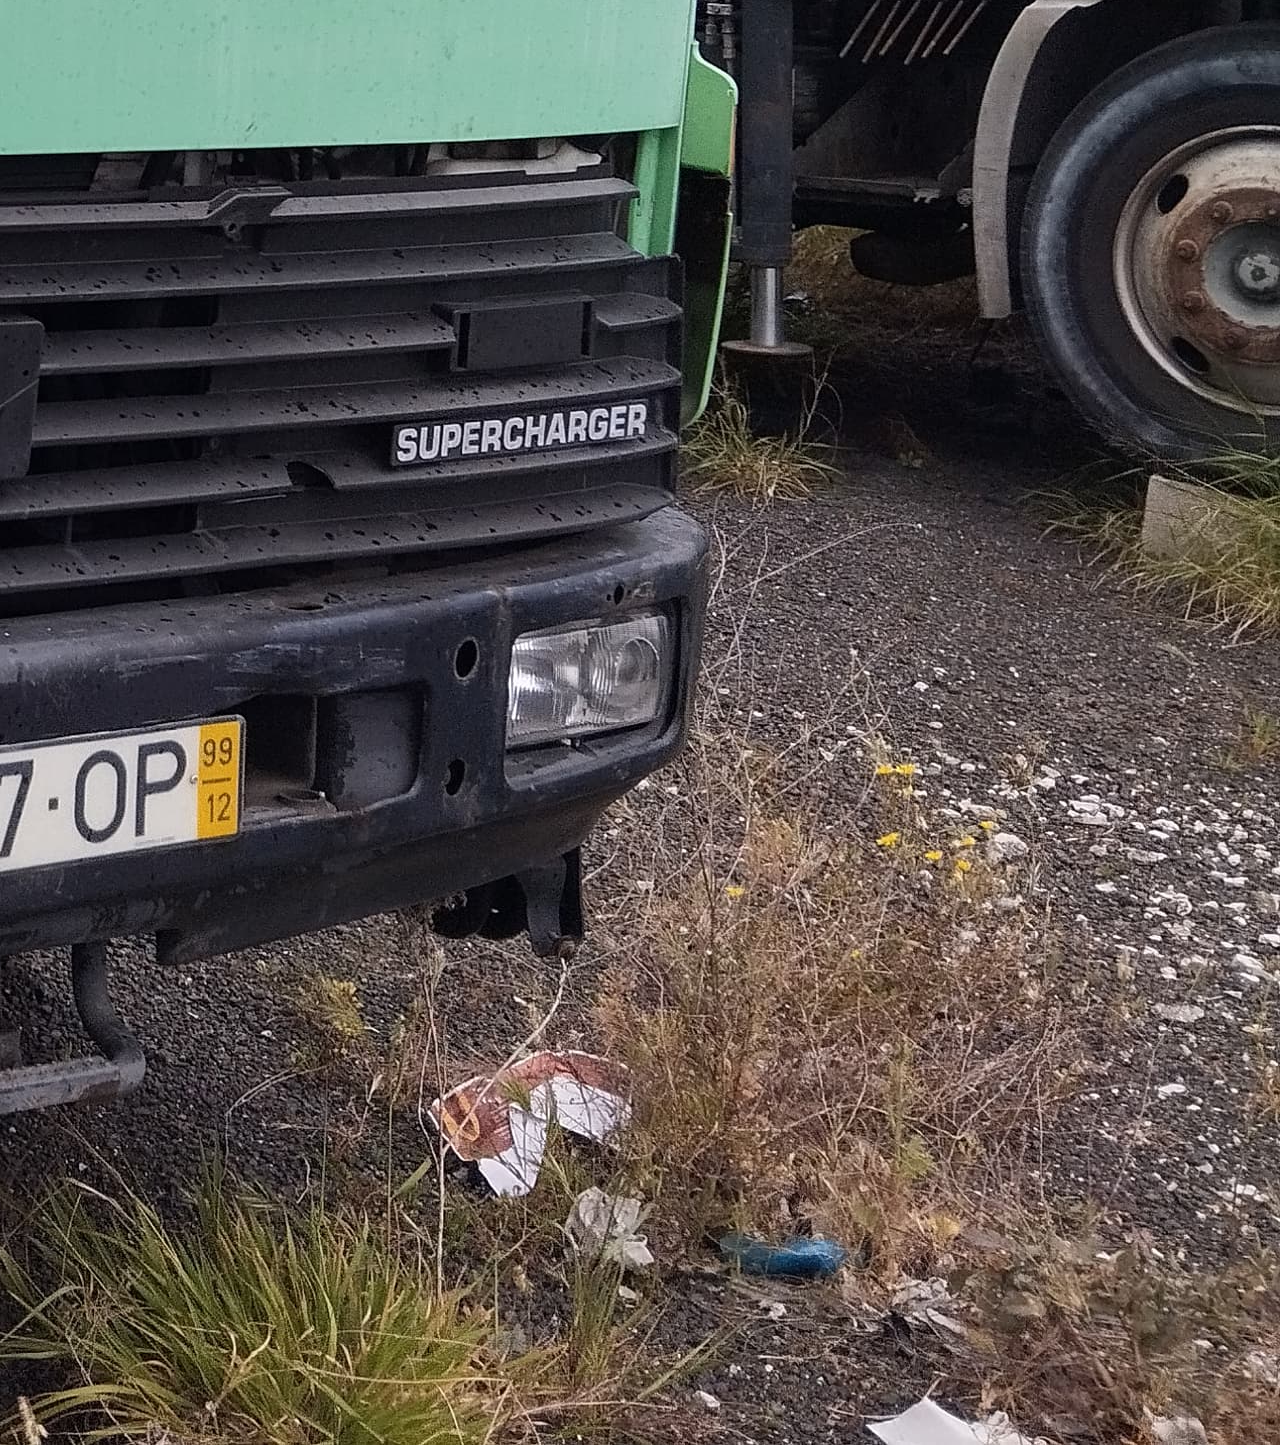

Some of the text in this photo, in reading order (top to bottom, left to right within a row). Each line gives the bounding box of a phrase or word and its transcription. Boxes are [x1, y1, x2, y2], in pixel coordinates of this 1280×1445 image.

[396, 404, 647, 462] SUPERCHARGER
[202, 737, 233, 767] 99
[206, 792, 232, 824] 12
